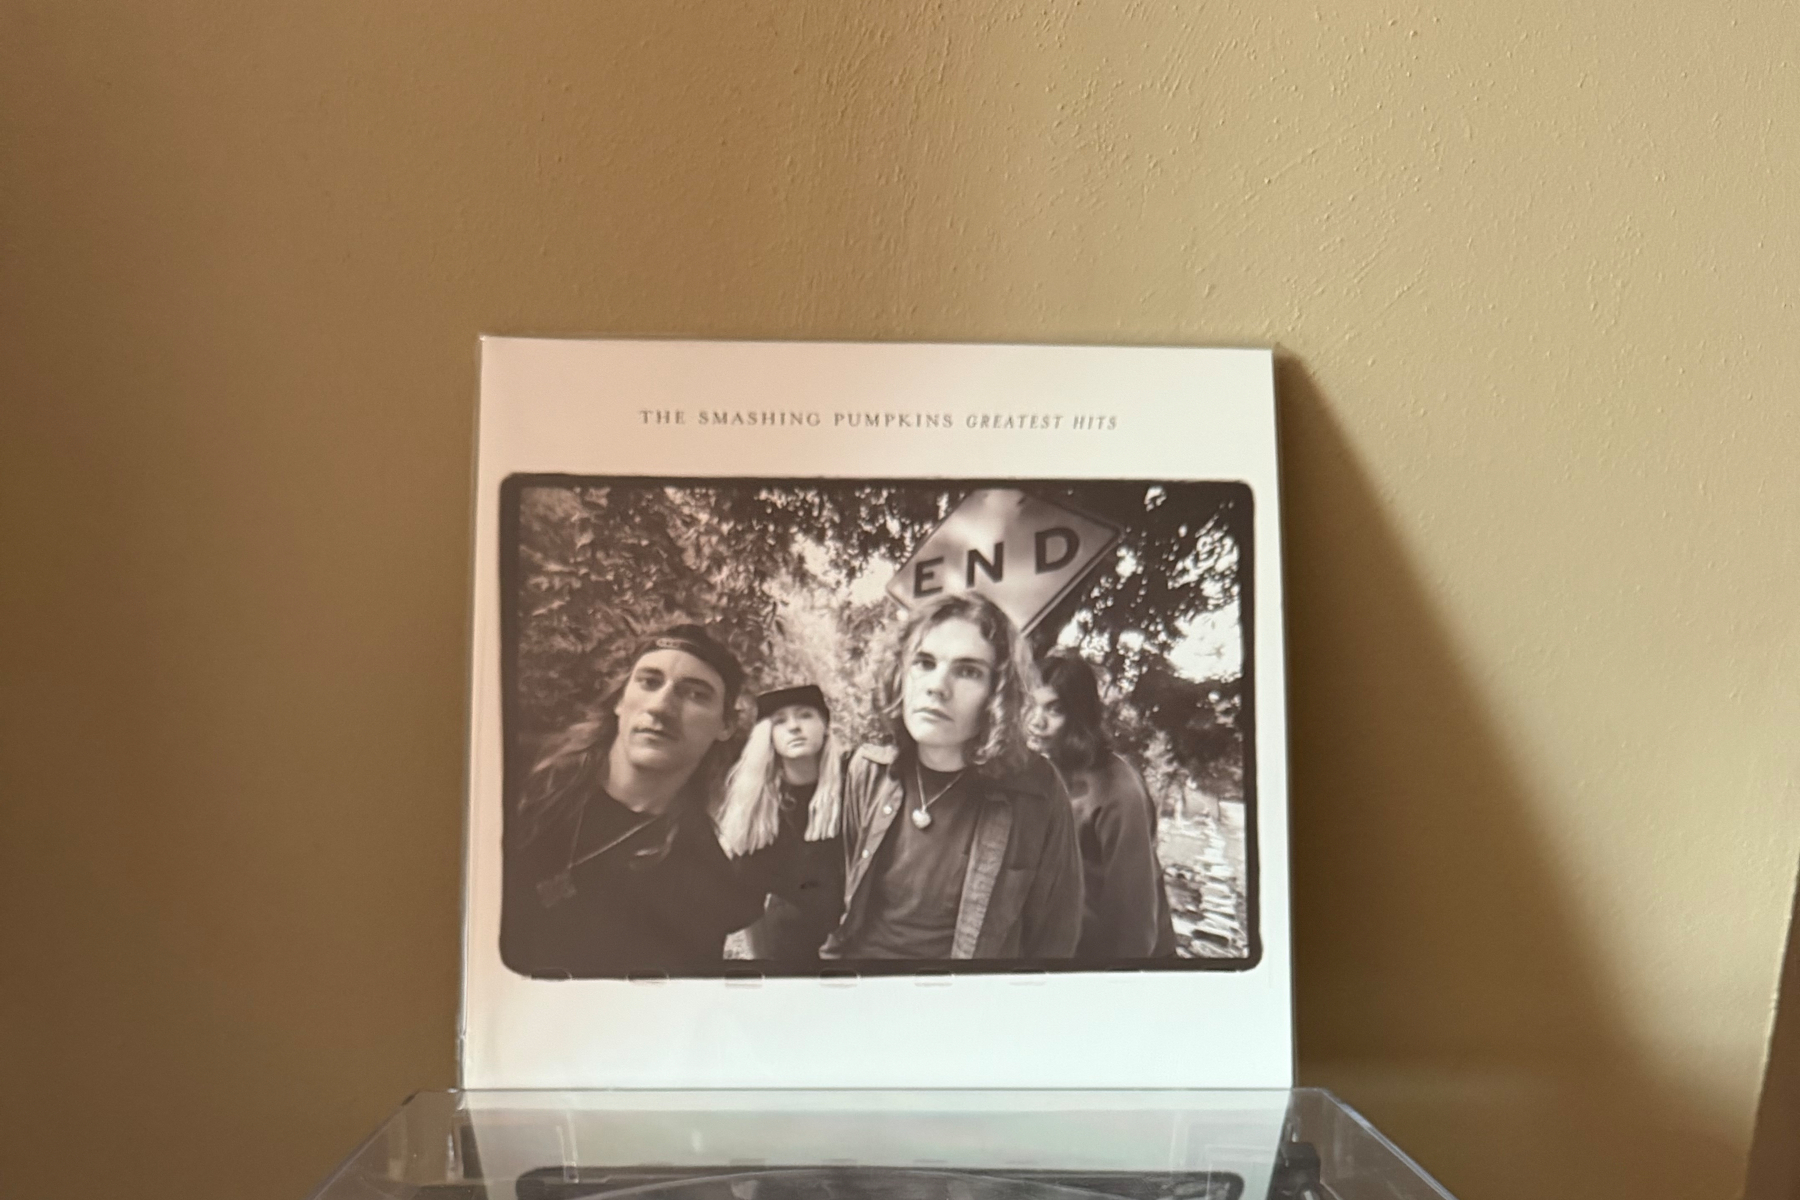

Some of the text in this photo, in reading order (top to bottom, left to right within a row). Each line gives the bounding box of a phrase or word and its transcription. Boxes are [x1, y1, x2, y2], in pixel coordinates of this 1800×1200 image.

[639, 409, 1118, 431] THE SMASHING PUMPKINS GREATEST HITS
[913, 526, 1081, 599] END
